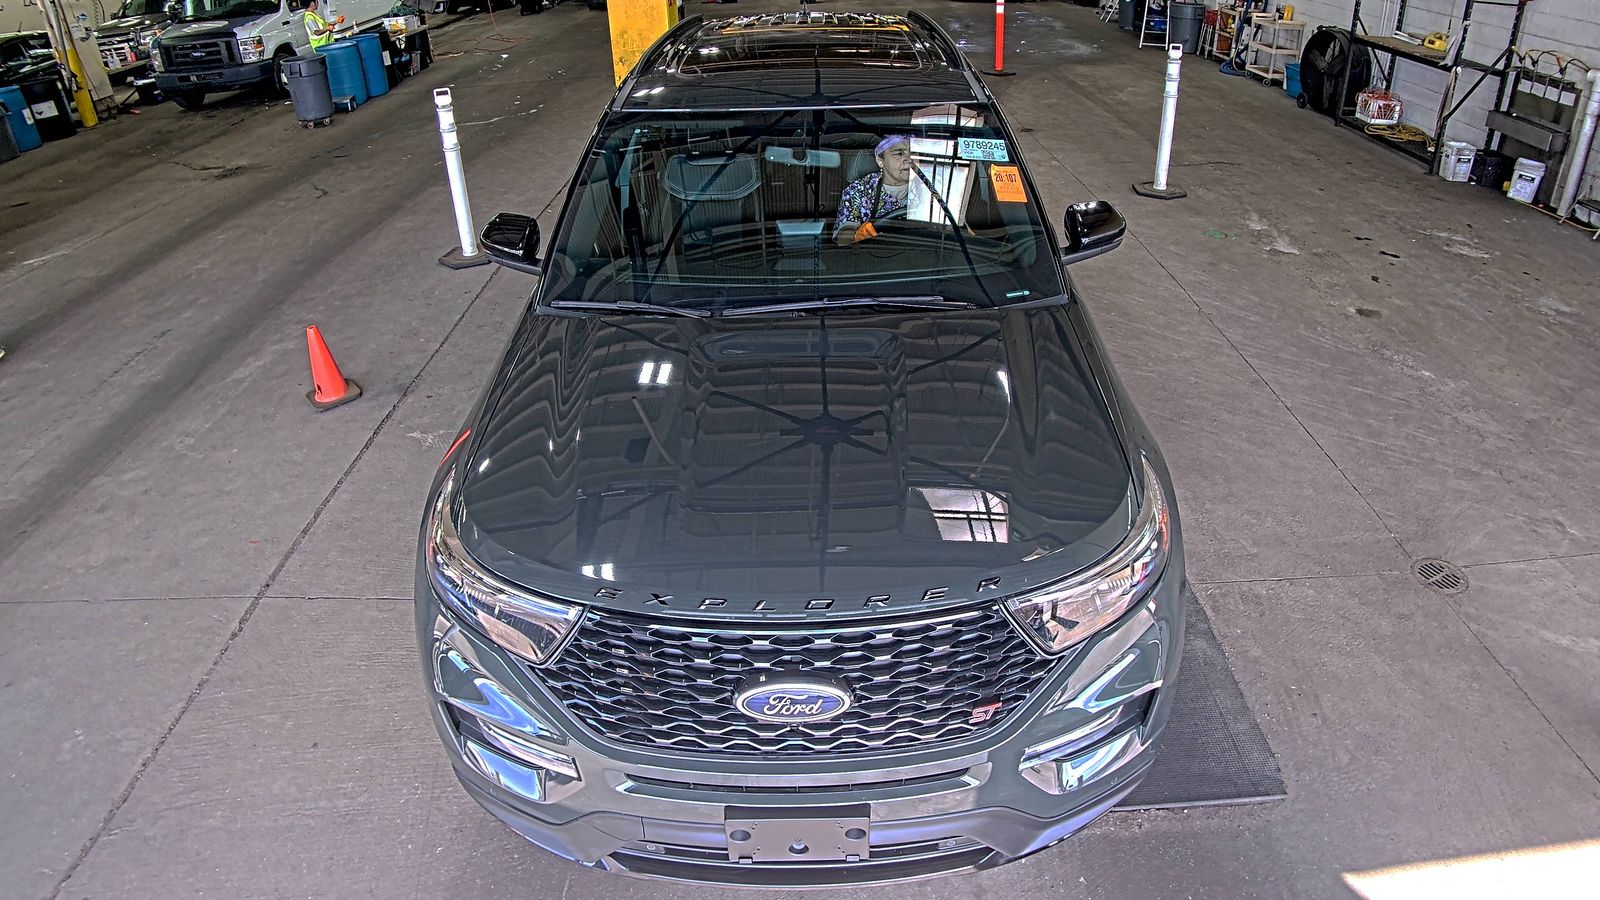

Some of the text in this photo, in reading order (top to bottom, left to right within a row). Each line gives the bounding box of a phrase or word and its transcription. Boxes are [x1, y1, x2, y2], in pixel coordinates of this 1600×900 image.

[963, 140, 1005, 151] 9789245
[594, 576, 1002, 612] EXPLORER
[763, 693, 823, 715] Ford
[969, 702, 1002, 724] ST
